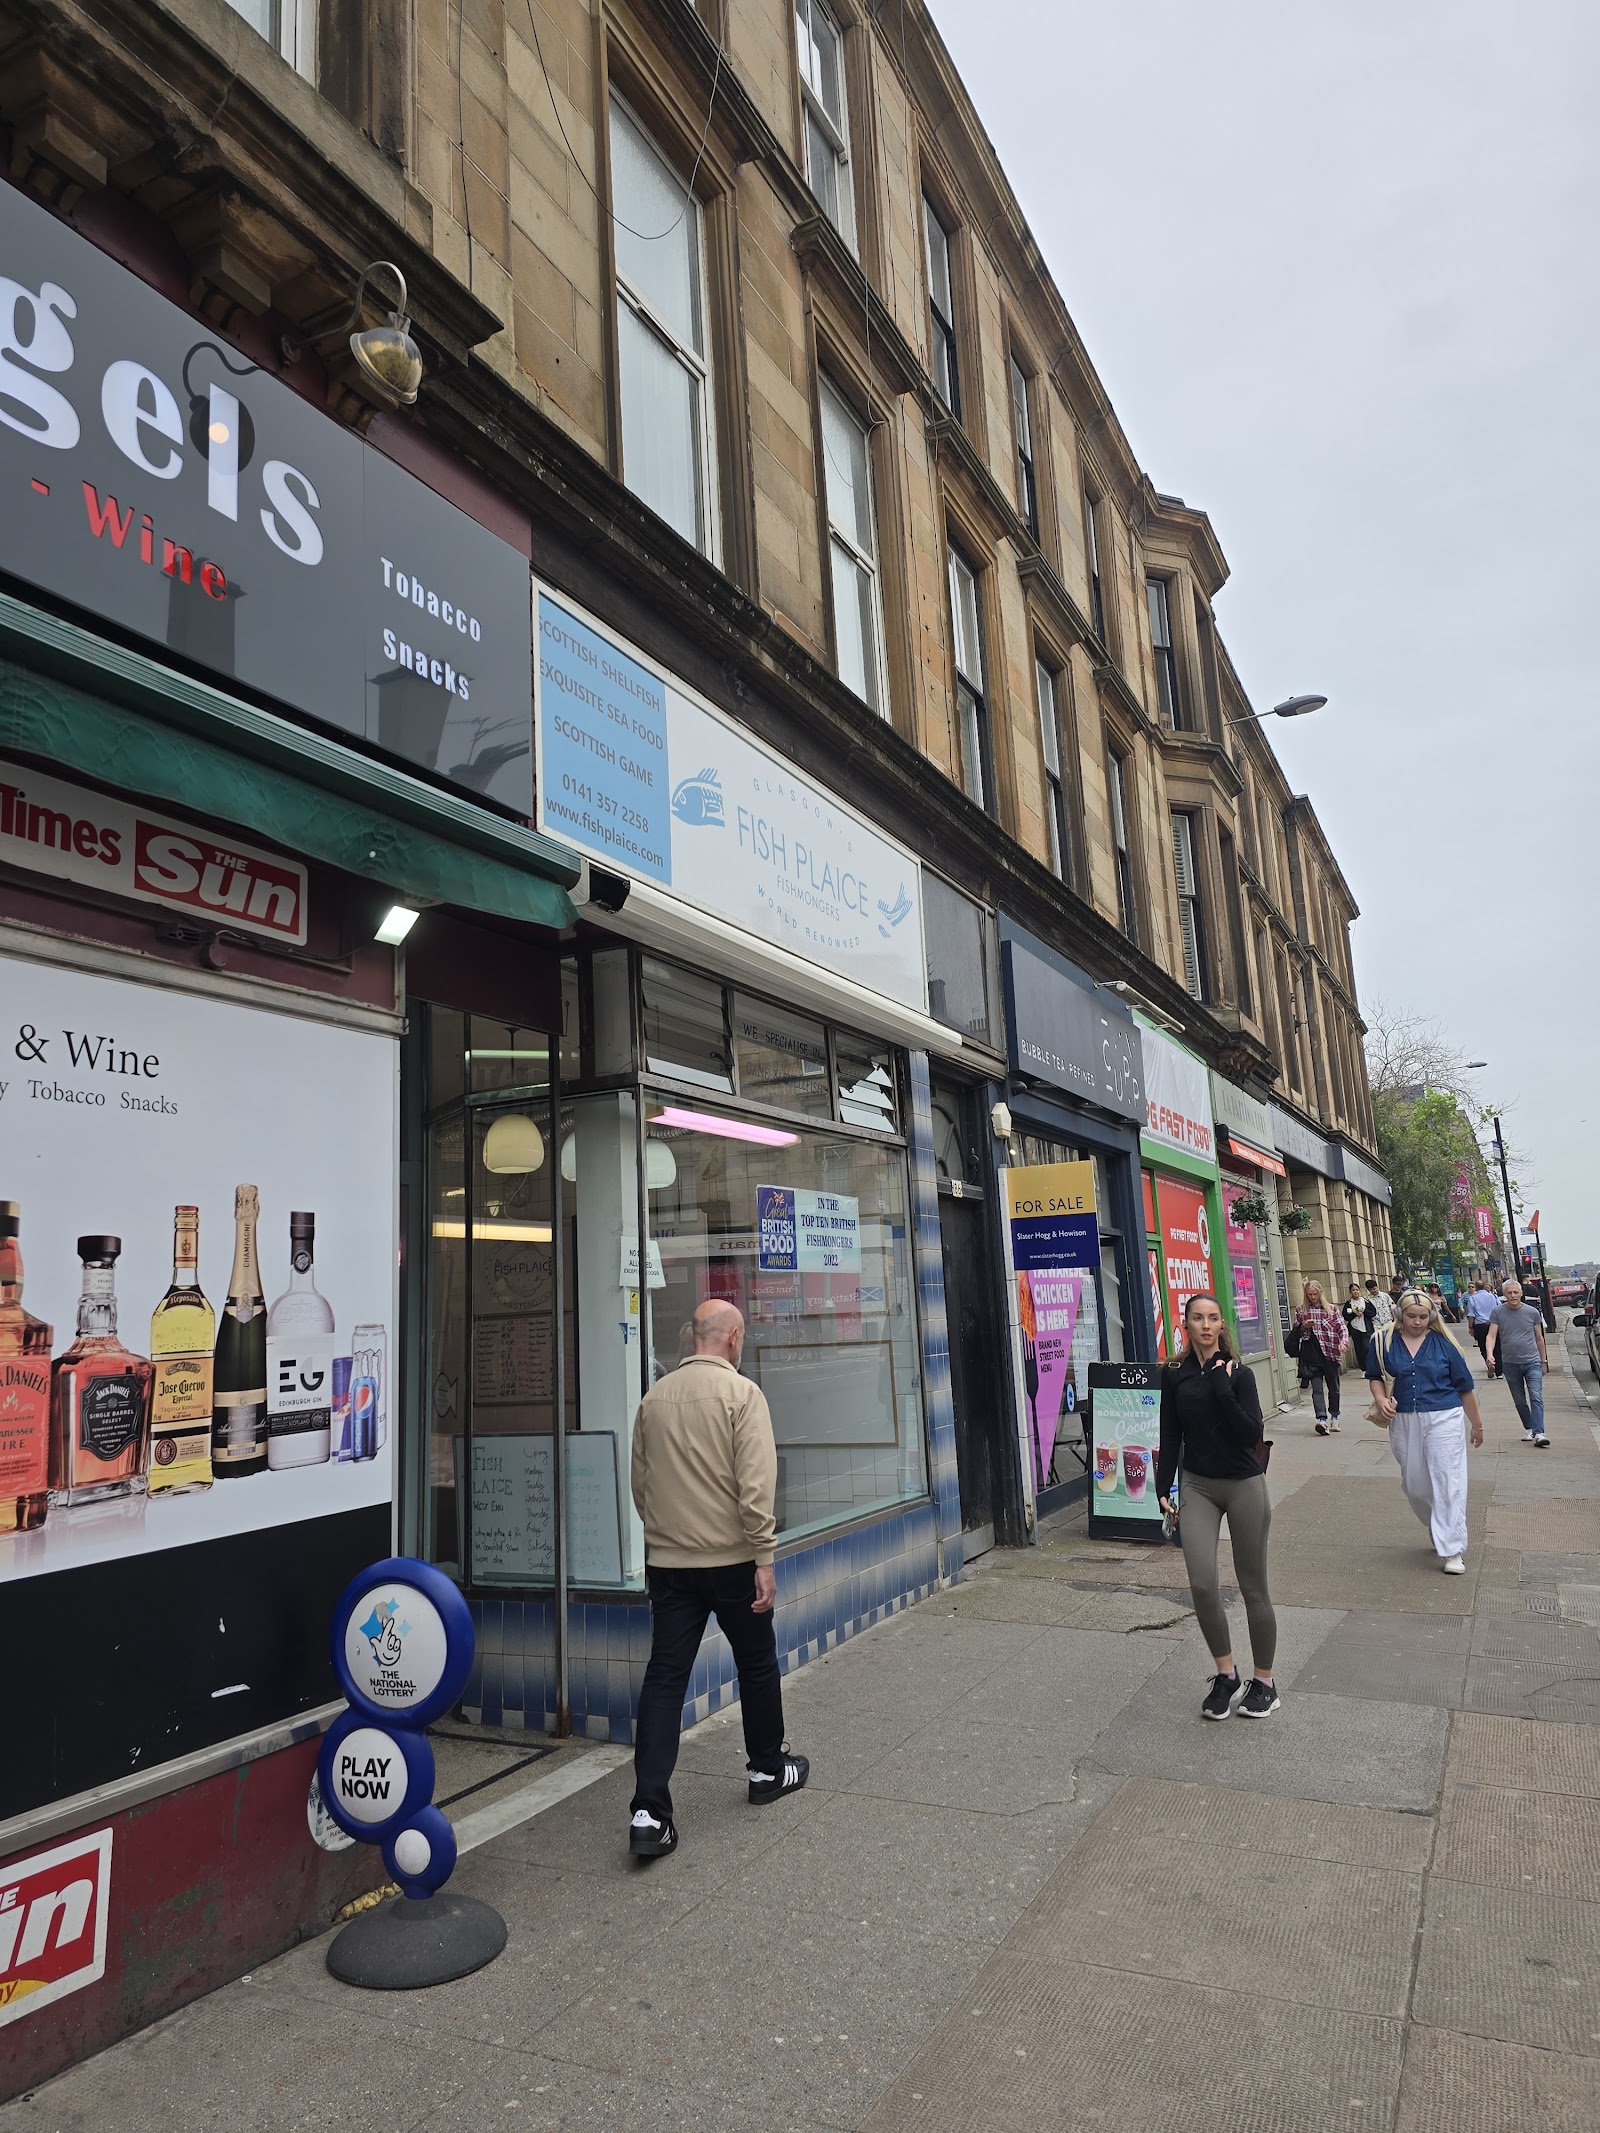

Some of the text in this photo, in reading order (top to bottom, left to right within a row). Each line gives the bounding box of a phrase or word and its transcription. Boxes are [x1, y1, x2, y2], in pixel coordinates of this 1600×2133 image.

[82, 480, 228, 601] Wine
[381, 556, 481, 643] Tobacco
[383, 627, 470, 701] Snacks
[601, 659, 660, 713] SHELLFISH
[540, 658, 663, 751] EXQUISITE SEA FOOD
[554, 715, 654, 787] SCOTTISH GAME
[562, 773, 649, 833] 0141 357 2258
[546, 797, 664, 868] www.fishplaice.com
[215, 850, 248, 873] THE
[737, 805, 869, 918] FISH PLAICE
[137, 834, 298, 928] Sun
[776, 874, 840, 922] FISHMONGERS
[758, 884, 860, 949] WORLD RENOWNED
[743, 1022, 758, 1040] WE
[766, 1031, 808, 1056] SPECIALISE
[15, 1024, 161, 1079] & Wine
[1021, 1038, 1051, 1066] BUBBLE
[1069, 1063, 1096, 1087] REFINED
[28, 1079, 106, 1107] Tobacco
[119, 1091, 178, 1115] Snacks
[1160, 1105, 1185, 1142] FAST
[765, 1197, 788, 1220] Great
[817, 1197, 840, 1212] IN THE
[1015, 1196, 1084, 1214] FOR SALE
[761, 1218, 794, 1235] BRITISH
[801, 1214, 856, 1231] TOP TEN BRITISH
[243, 1221, 251, 1268] CHAMPAGNE
[762, 1234, 795, 1254] FOOD
[806, 1233, 853, 1249] FISHMONGERS
[1016, 1229, 1087, 1241] Slater Hogg & Howison
[629, 1249, 637, 1257] NO
[767, 1255, 792, 1267] AWARDS
[823, 1254, 839, 1267] 2022
[494, 1261, 553, 1276] FISH PLAICE
[628, 1260, 653, 1269] ALLED
[1166, 1257, 1210, 1291] COMING
[1033, 1283, 1075, 1306] CHICKEN
[1036, 1308, 1070, 1332] IS HERE
[1038, 1338, 1062, 1350] BRAND NEW
[1039, 1349, 1065, 1362] STREET FOOD
[6, 1365, 49, 1395] DANIEL'S
[279, 1356, 324, 1394] EG
[1041, 1364, 1053, 1374] MENU
[96, 1386, 110, 1401] JACK
[159, 1379, 206, 1397] Jose Cuervo
[278, 1396, 322, 1408] EDINBURGH GIN
[89, 1409, 134, 1420] SINGLE BARREL
[102, 1417, 122, 1425] SELECT
[1097, 1410, 1120, 1418] BOBA
[354, 1418, 362, 1453] pepsi
[472, 1446, 503, 1473] FISH
[524, 1465, 544, 1482] Monday
[525, 1508, 551, 1527] Thursday
[526, 1521, 544, 1538] Friday
[527, 1538, 555, 1560] Saturday
[528, 1557, 554, 1574] Sunday
[370, 1677, 416, 1689] NATIONAL
[381, 1670, 400, 1680] THE
[373, 1687, 415, 1697] LOTTERY
[341, 1755, 391, 1780] PLAY
[341, 1777, 391, 1800] NOW
